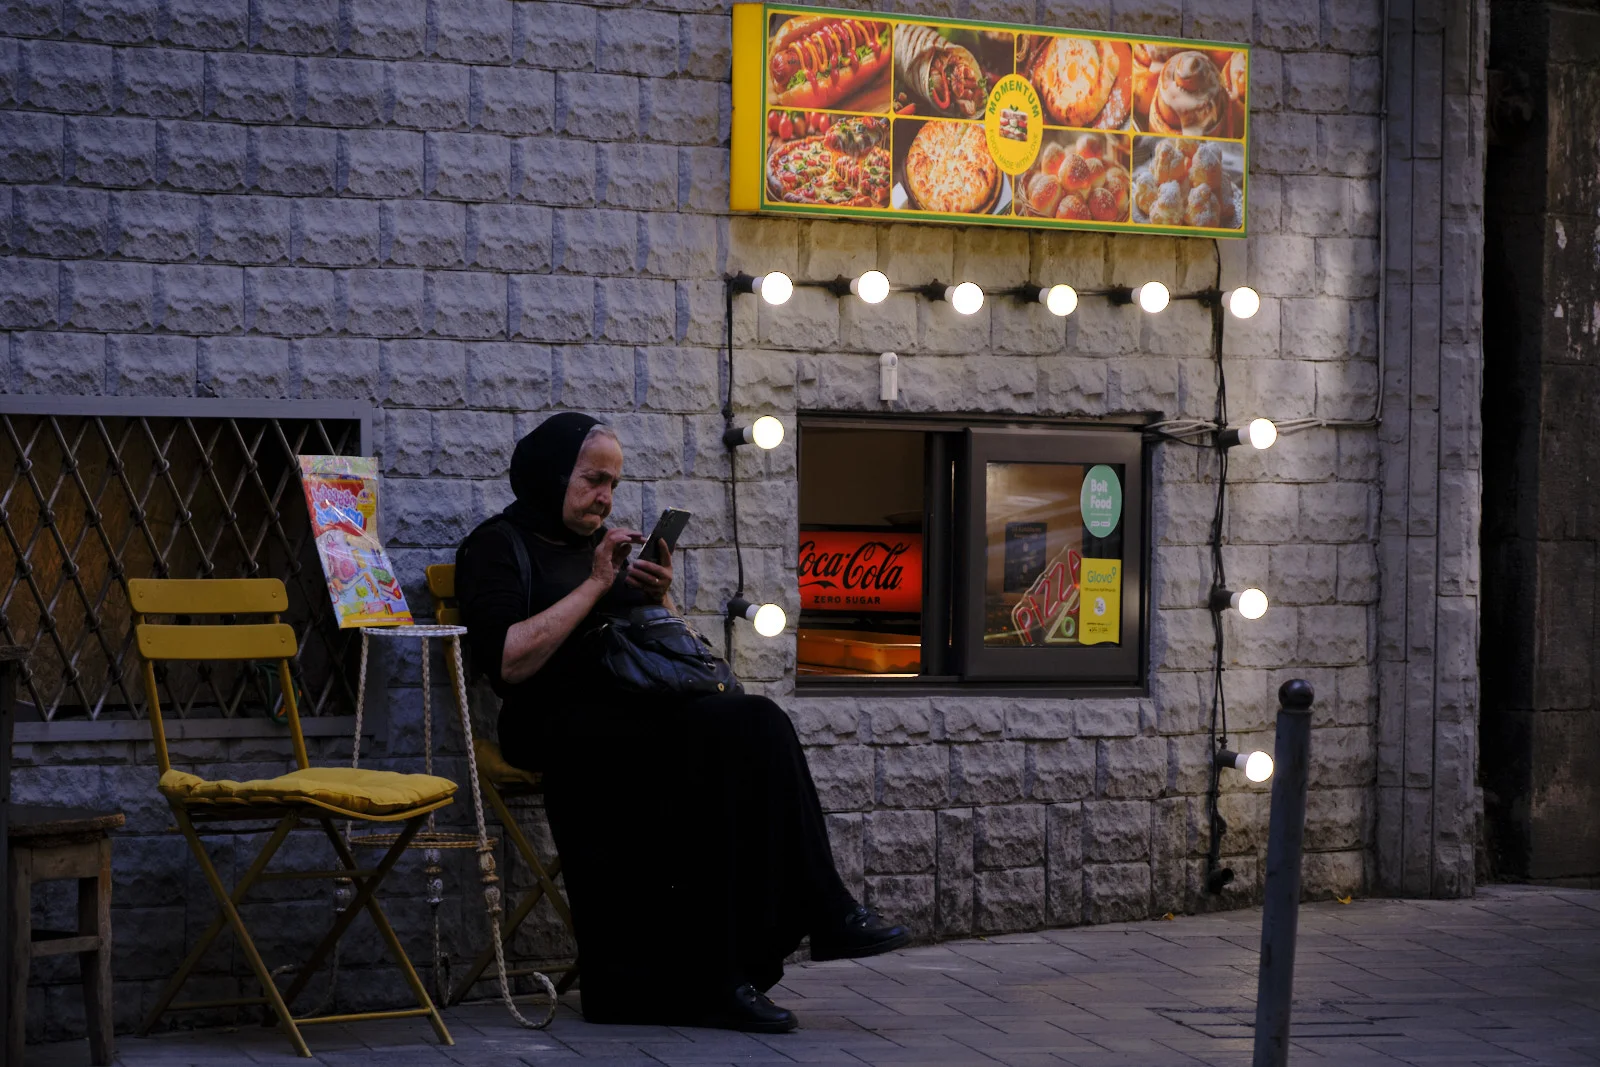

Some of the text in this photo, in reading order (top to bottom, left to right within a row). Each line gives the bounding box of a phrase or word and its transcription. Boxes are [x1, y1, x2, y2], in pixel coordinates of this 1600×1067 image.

[988, 80, 1040, 117] MOMENTUM
[1090, 479, 1107, 492] Bolt
[1090, 495, 1112, 509] Food
[1087, 570, 1113, 583] Glovo
[814, 595, 881, 605] ZERO SUGAR
